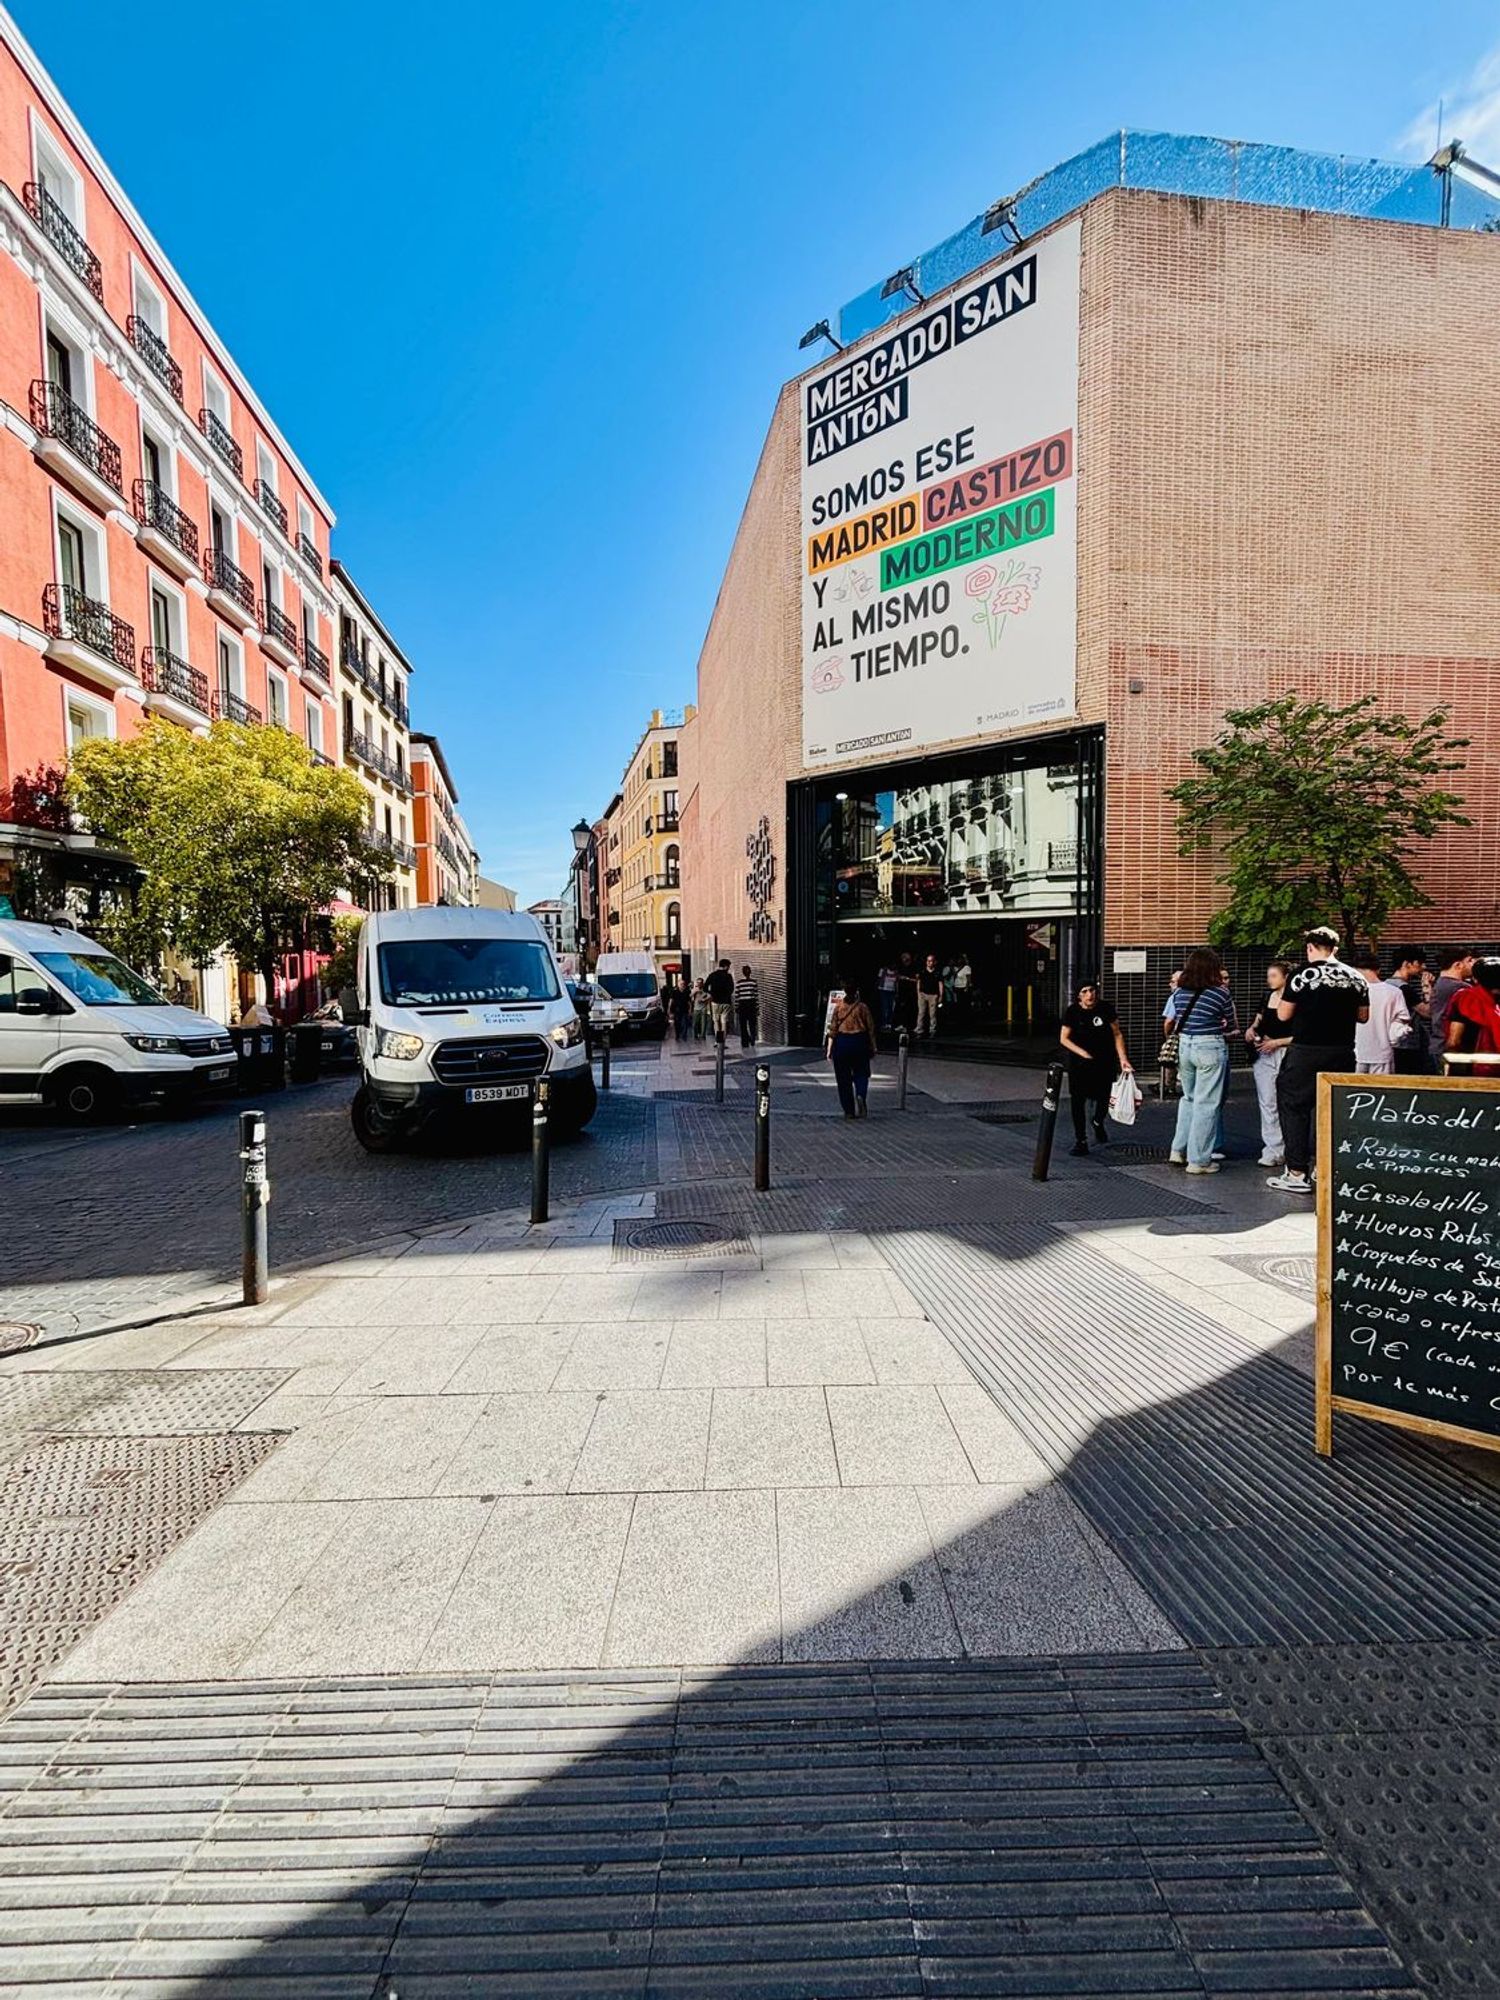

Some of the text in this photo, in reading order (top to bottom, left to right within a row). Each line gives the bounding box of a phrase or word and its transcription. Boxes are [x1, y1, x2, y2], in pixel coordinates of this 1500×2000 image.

[809, 262, 1031, 419] MERCADO SAN
[811, 426, 975, 526] SOMOS ESE
[812, 438, 1066, 569] MADRID CASTIZO
[885, 498, 1047, 586] MODERNO
[812, 577, 829, 609] Y
[813, 580, 950, 652] AL MISMO
[850, 624, 970, 683] TIEMPO.
[986, 707, 1020, 722] MADRID
[870, 735, 884, 746] SAN
[474, 1086, 526, 1100] 8539 MDT
[1346, 1093, 1440, 1126] Platos
[1444, 1108, 1484, 1129] del
[1358, 1137, 1422, 1158] Rabas
[1356, 1158, 1376, 1170] de
[1354, 1183, 1489, 1215] Ensaladilla
[1355, 1214, 1493, 1245] Huevos Rotos
[1444, 1259, 1464, 1273] de
[1352, 1273, 1428, 1304] Milhoja
[1433, 1289, 1457, 1307] de
[1356, 1304, 1410, 1324] caña
[1420, 1319, 1432, 1328] o
[1343, 1364, 1383, 1382] Por
[1427, 1386, 1470, 1402] más
